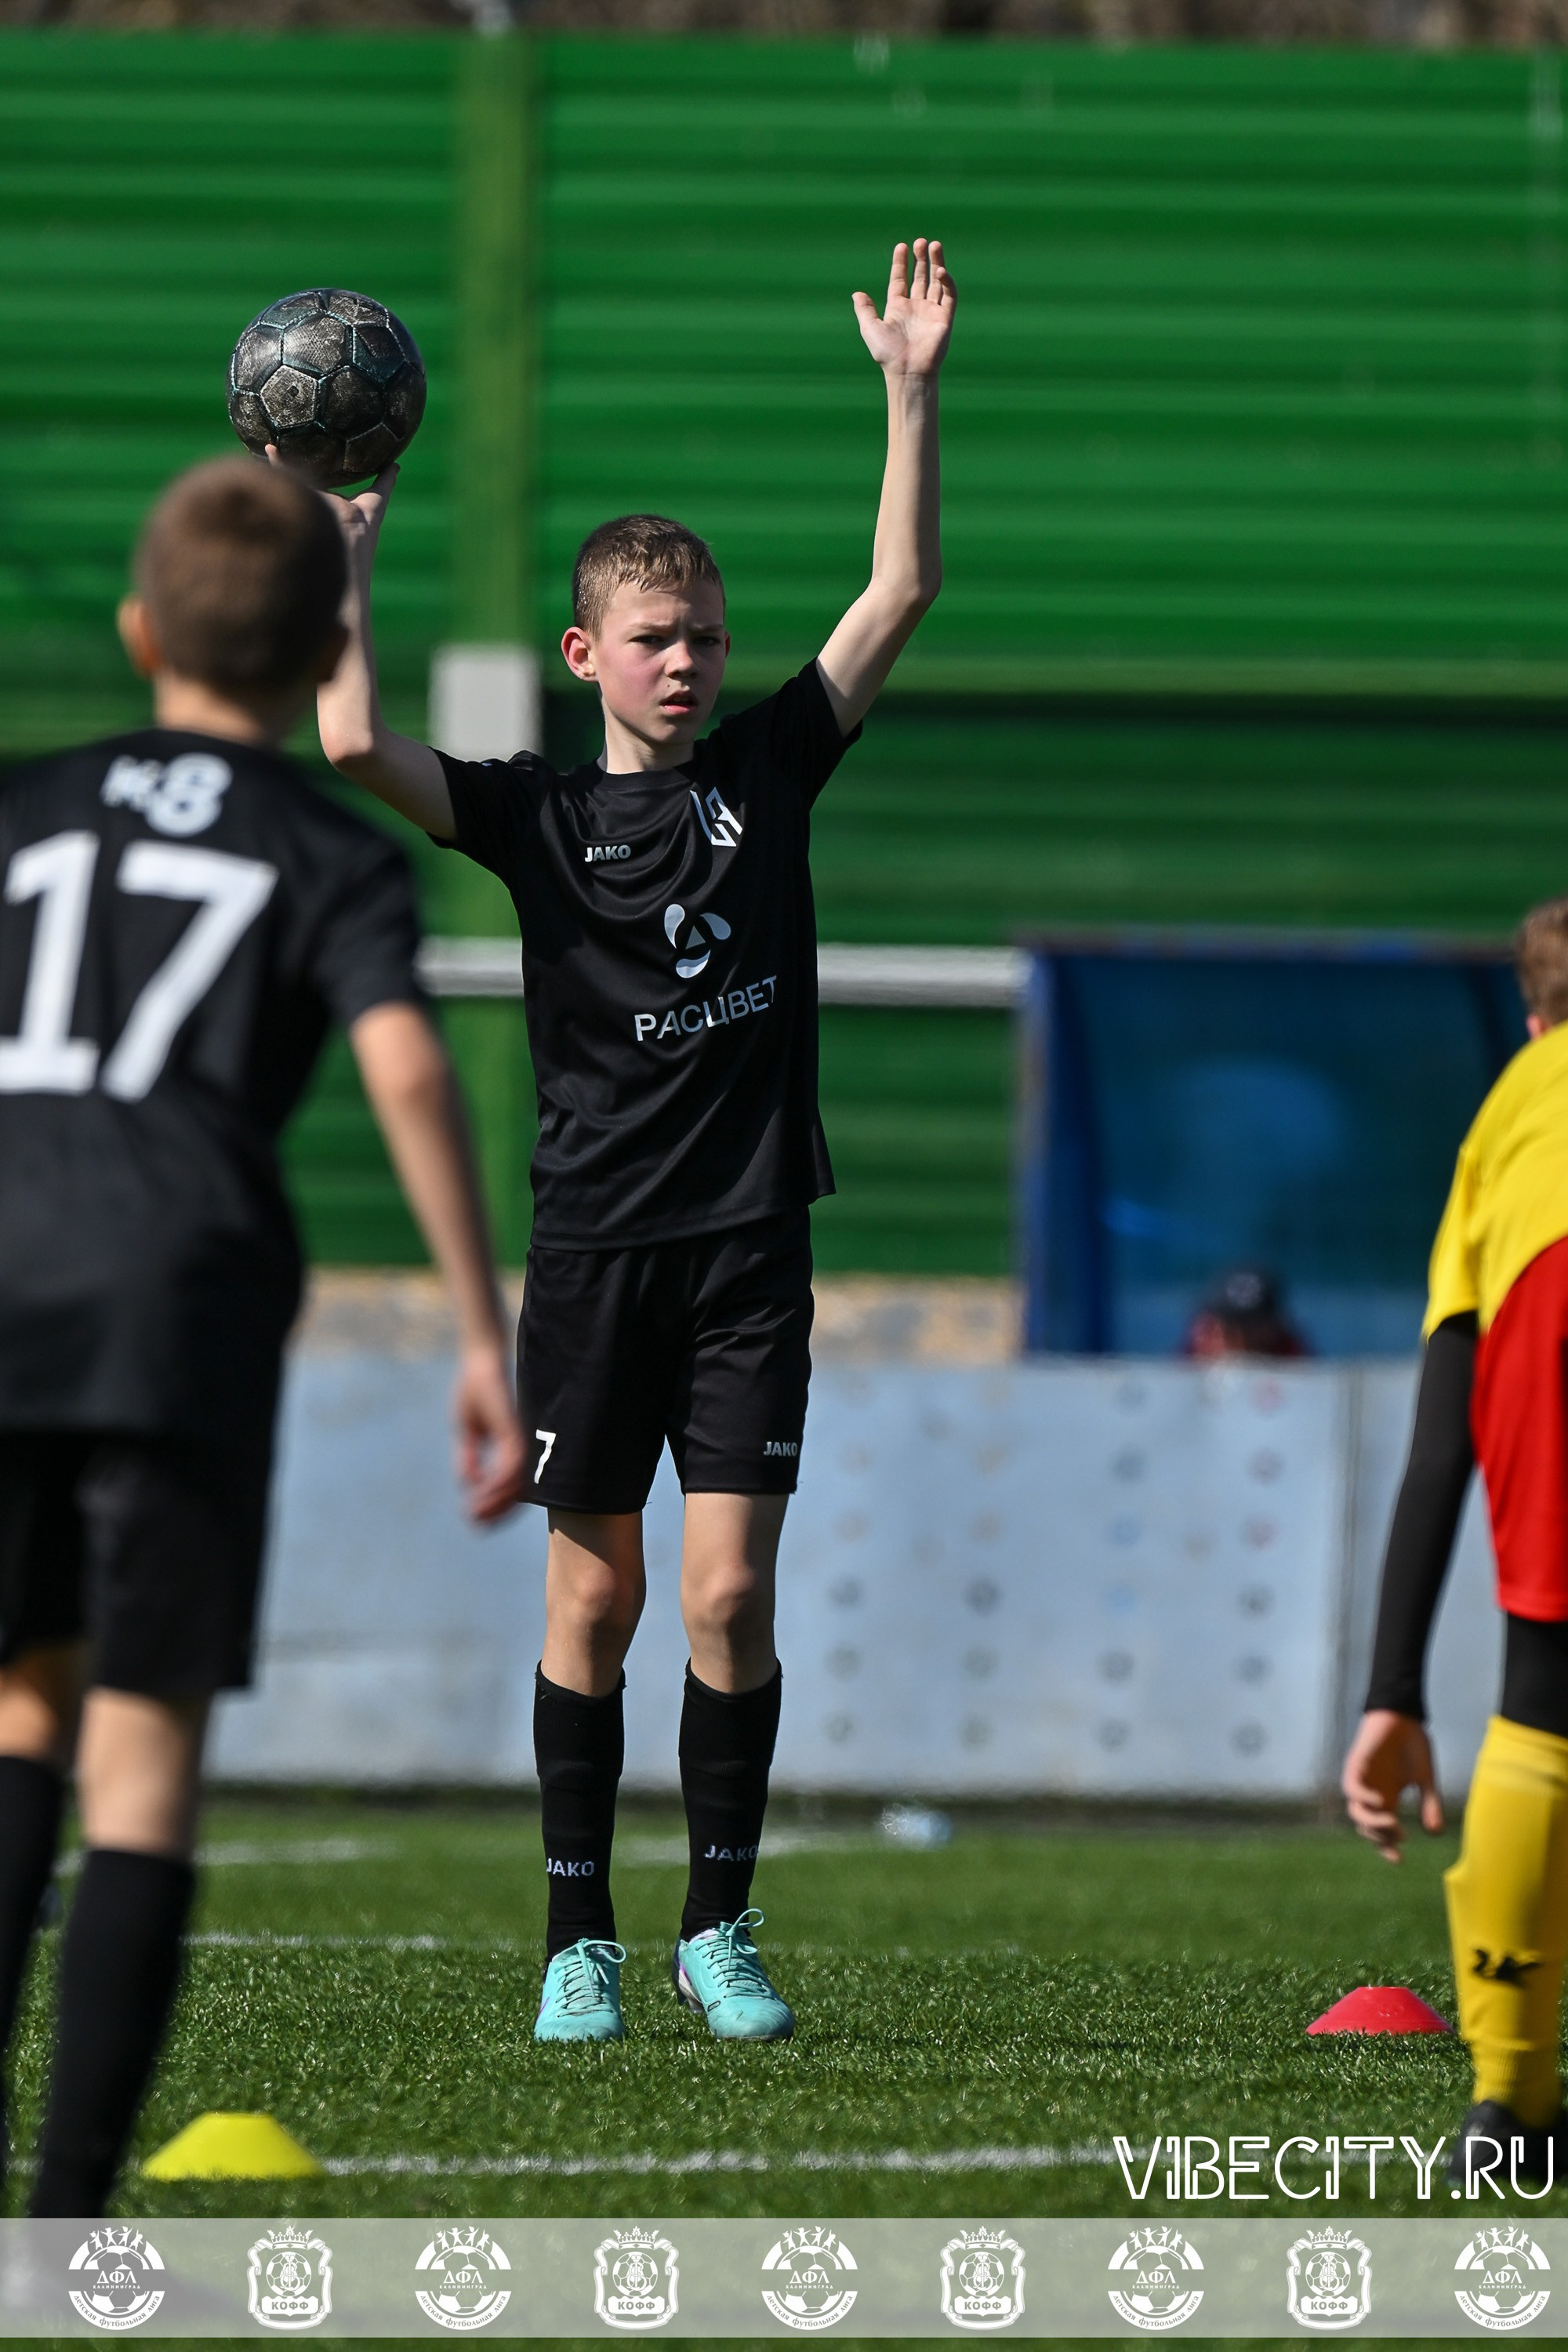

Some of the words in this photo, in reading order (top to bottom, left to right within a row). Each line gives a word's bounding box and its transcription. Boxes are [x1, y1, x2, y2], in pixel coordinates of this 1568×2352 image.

[585, 845, 631, 862] JAKO
[0, 829, 280, 1104] 17
[634, 975, 777, 1041] РАСЦВЕТ
[533, 1429, 557, 1484] 7
[764, 1441, 798, 1457] JAKO
[703, 1844, 759, 1862] JAKO
[546, 1857, 594, 1877] JAKO
